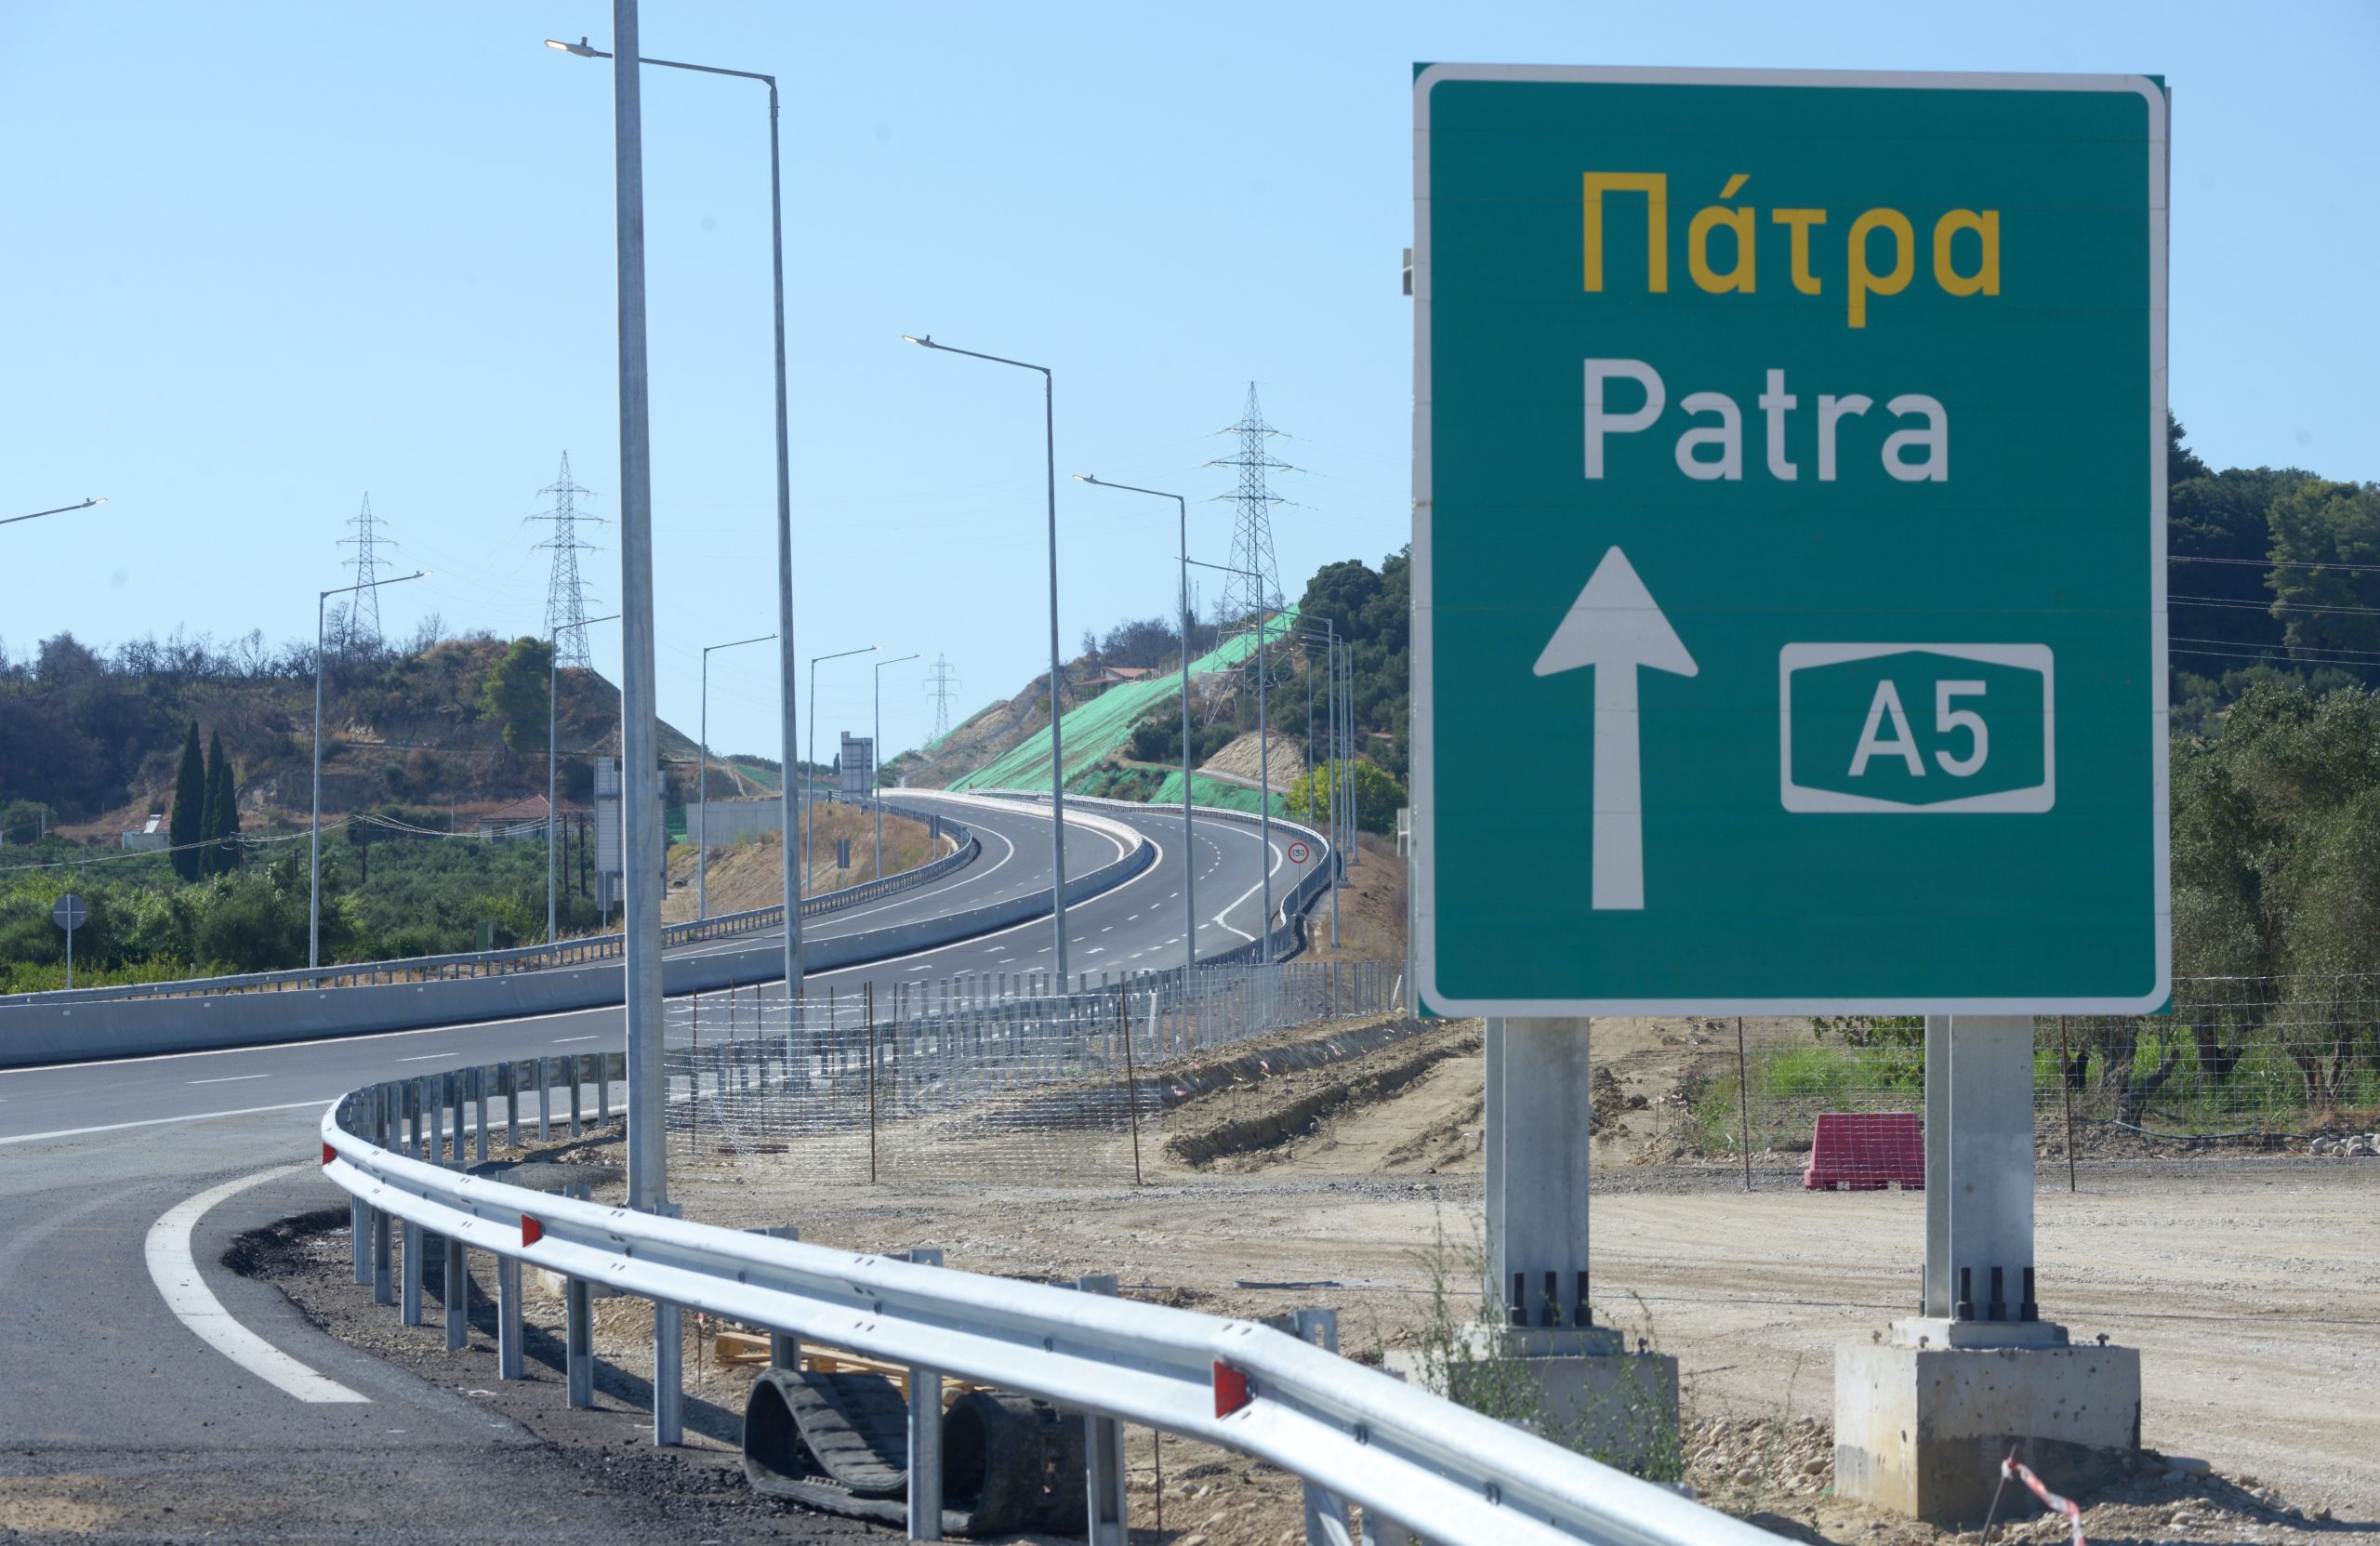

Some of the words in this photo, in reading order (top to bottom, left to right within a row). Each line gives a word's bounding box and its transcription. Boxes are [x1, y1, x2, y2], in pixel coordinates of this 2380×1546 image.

[1582, 172, 2001, 328] Πάτρα
[1582, 358, 1949, 482] Patra
[1847, 679, 1990, 777] A5
[1291, 849, 1305, 857] 130
